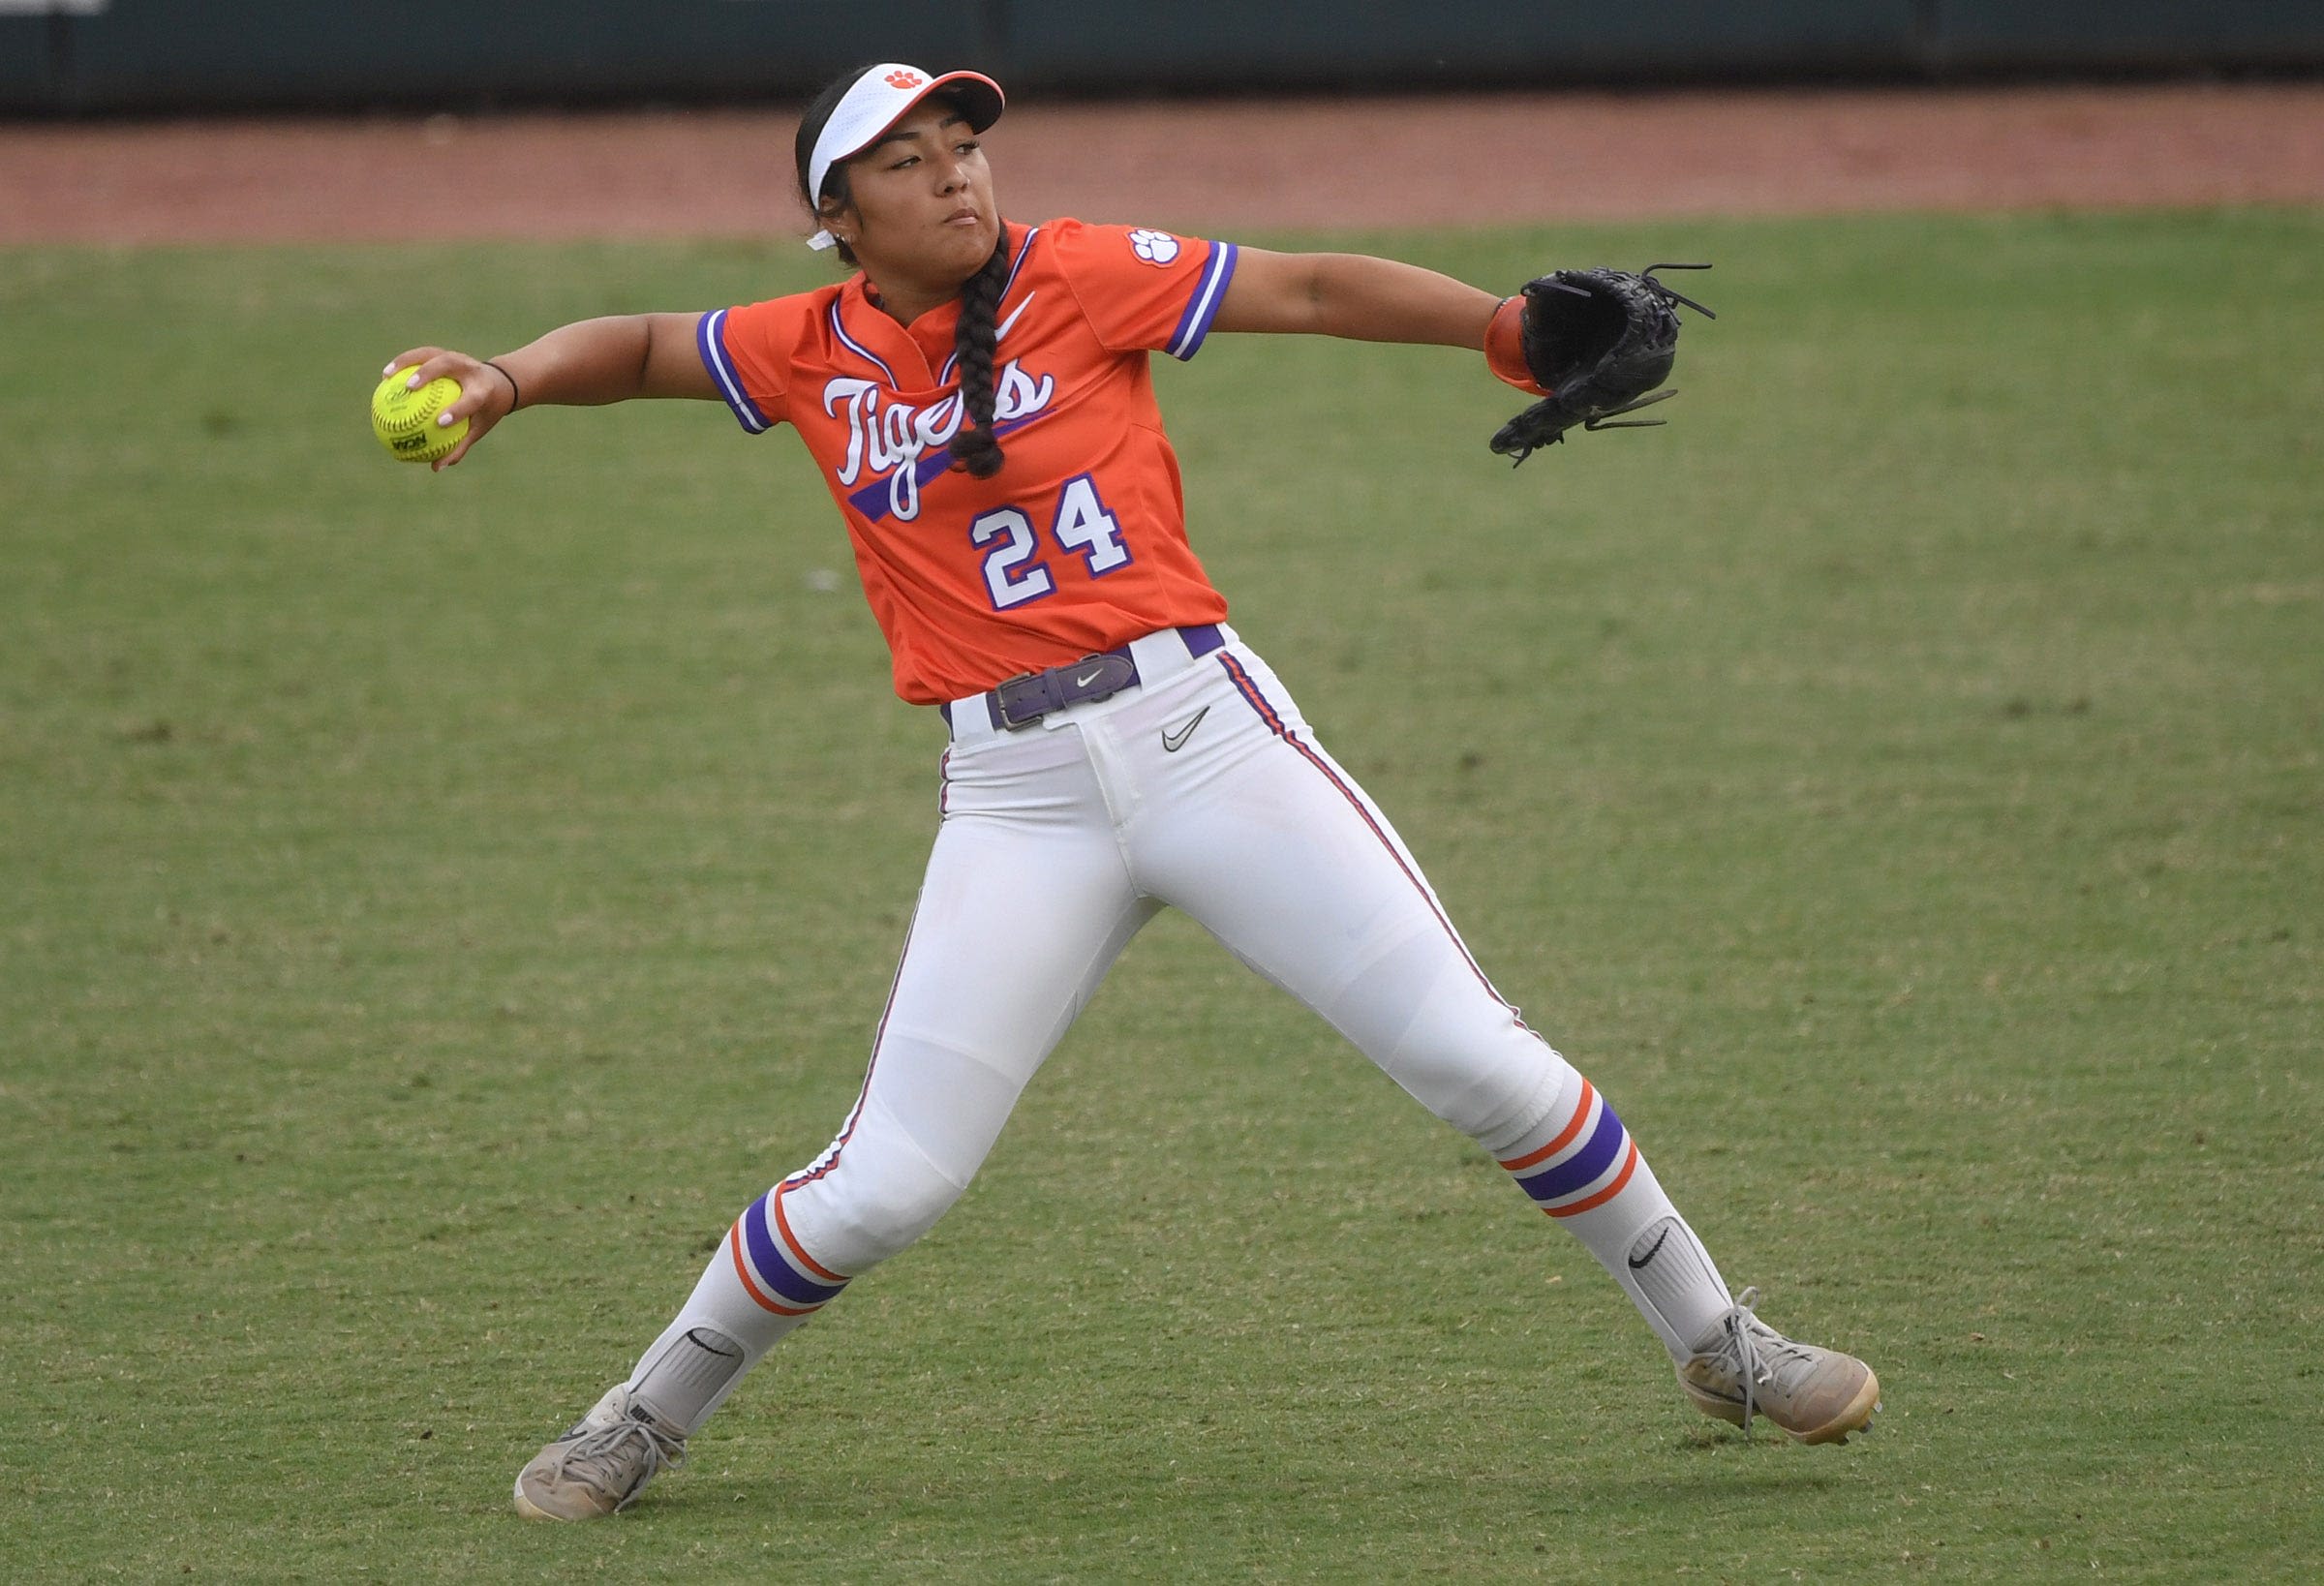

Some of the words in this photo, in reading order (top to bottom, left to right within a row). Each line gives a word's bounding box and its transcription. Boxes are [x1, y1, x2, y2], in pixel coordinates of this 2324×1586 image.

[823, 358, 1055, 522] Tiges
[969, 472, 1133, 611] 24
[630, 1404, 656, 1424] NIKE
